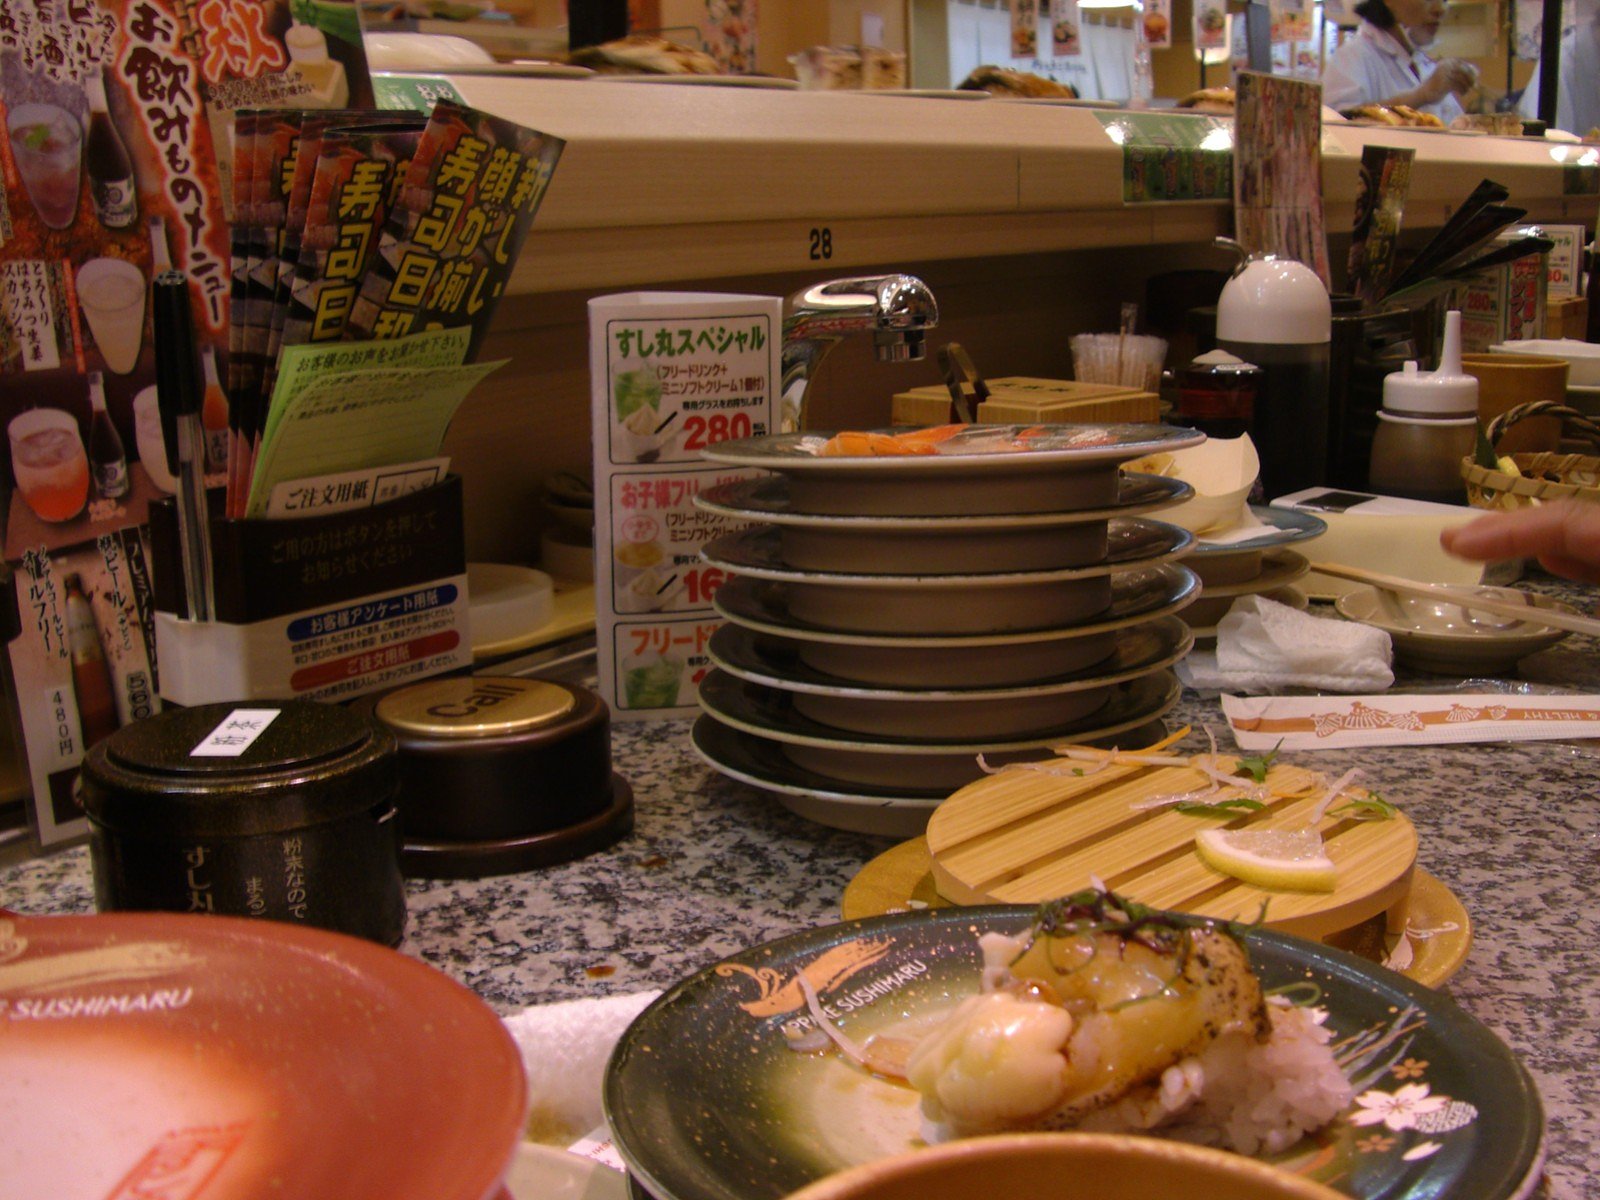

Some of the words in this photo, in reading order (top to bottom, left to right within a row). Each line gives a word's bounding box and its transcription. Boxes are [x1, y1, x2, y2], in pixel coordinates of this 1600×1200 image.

[124, 1, 227, 326] お飲みものメニュー
[810, 228, 832, 259] 28
[615, 326, 766, 358] すし丸スペシャル
[683, 412, 751, 451] 280
[285, 478, 370, 511] ご注文用紙
[310, 589, 440, 635] お客様アンケート用紙
[427, 684, 526, 718] Call
[52, 691, 73, 757] 480円
[9, 986, 194, 1020] SUSHIMARU
[836, 958, 928, 1012] SUSHIMARU
